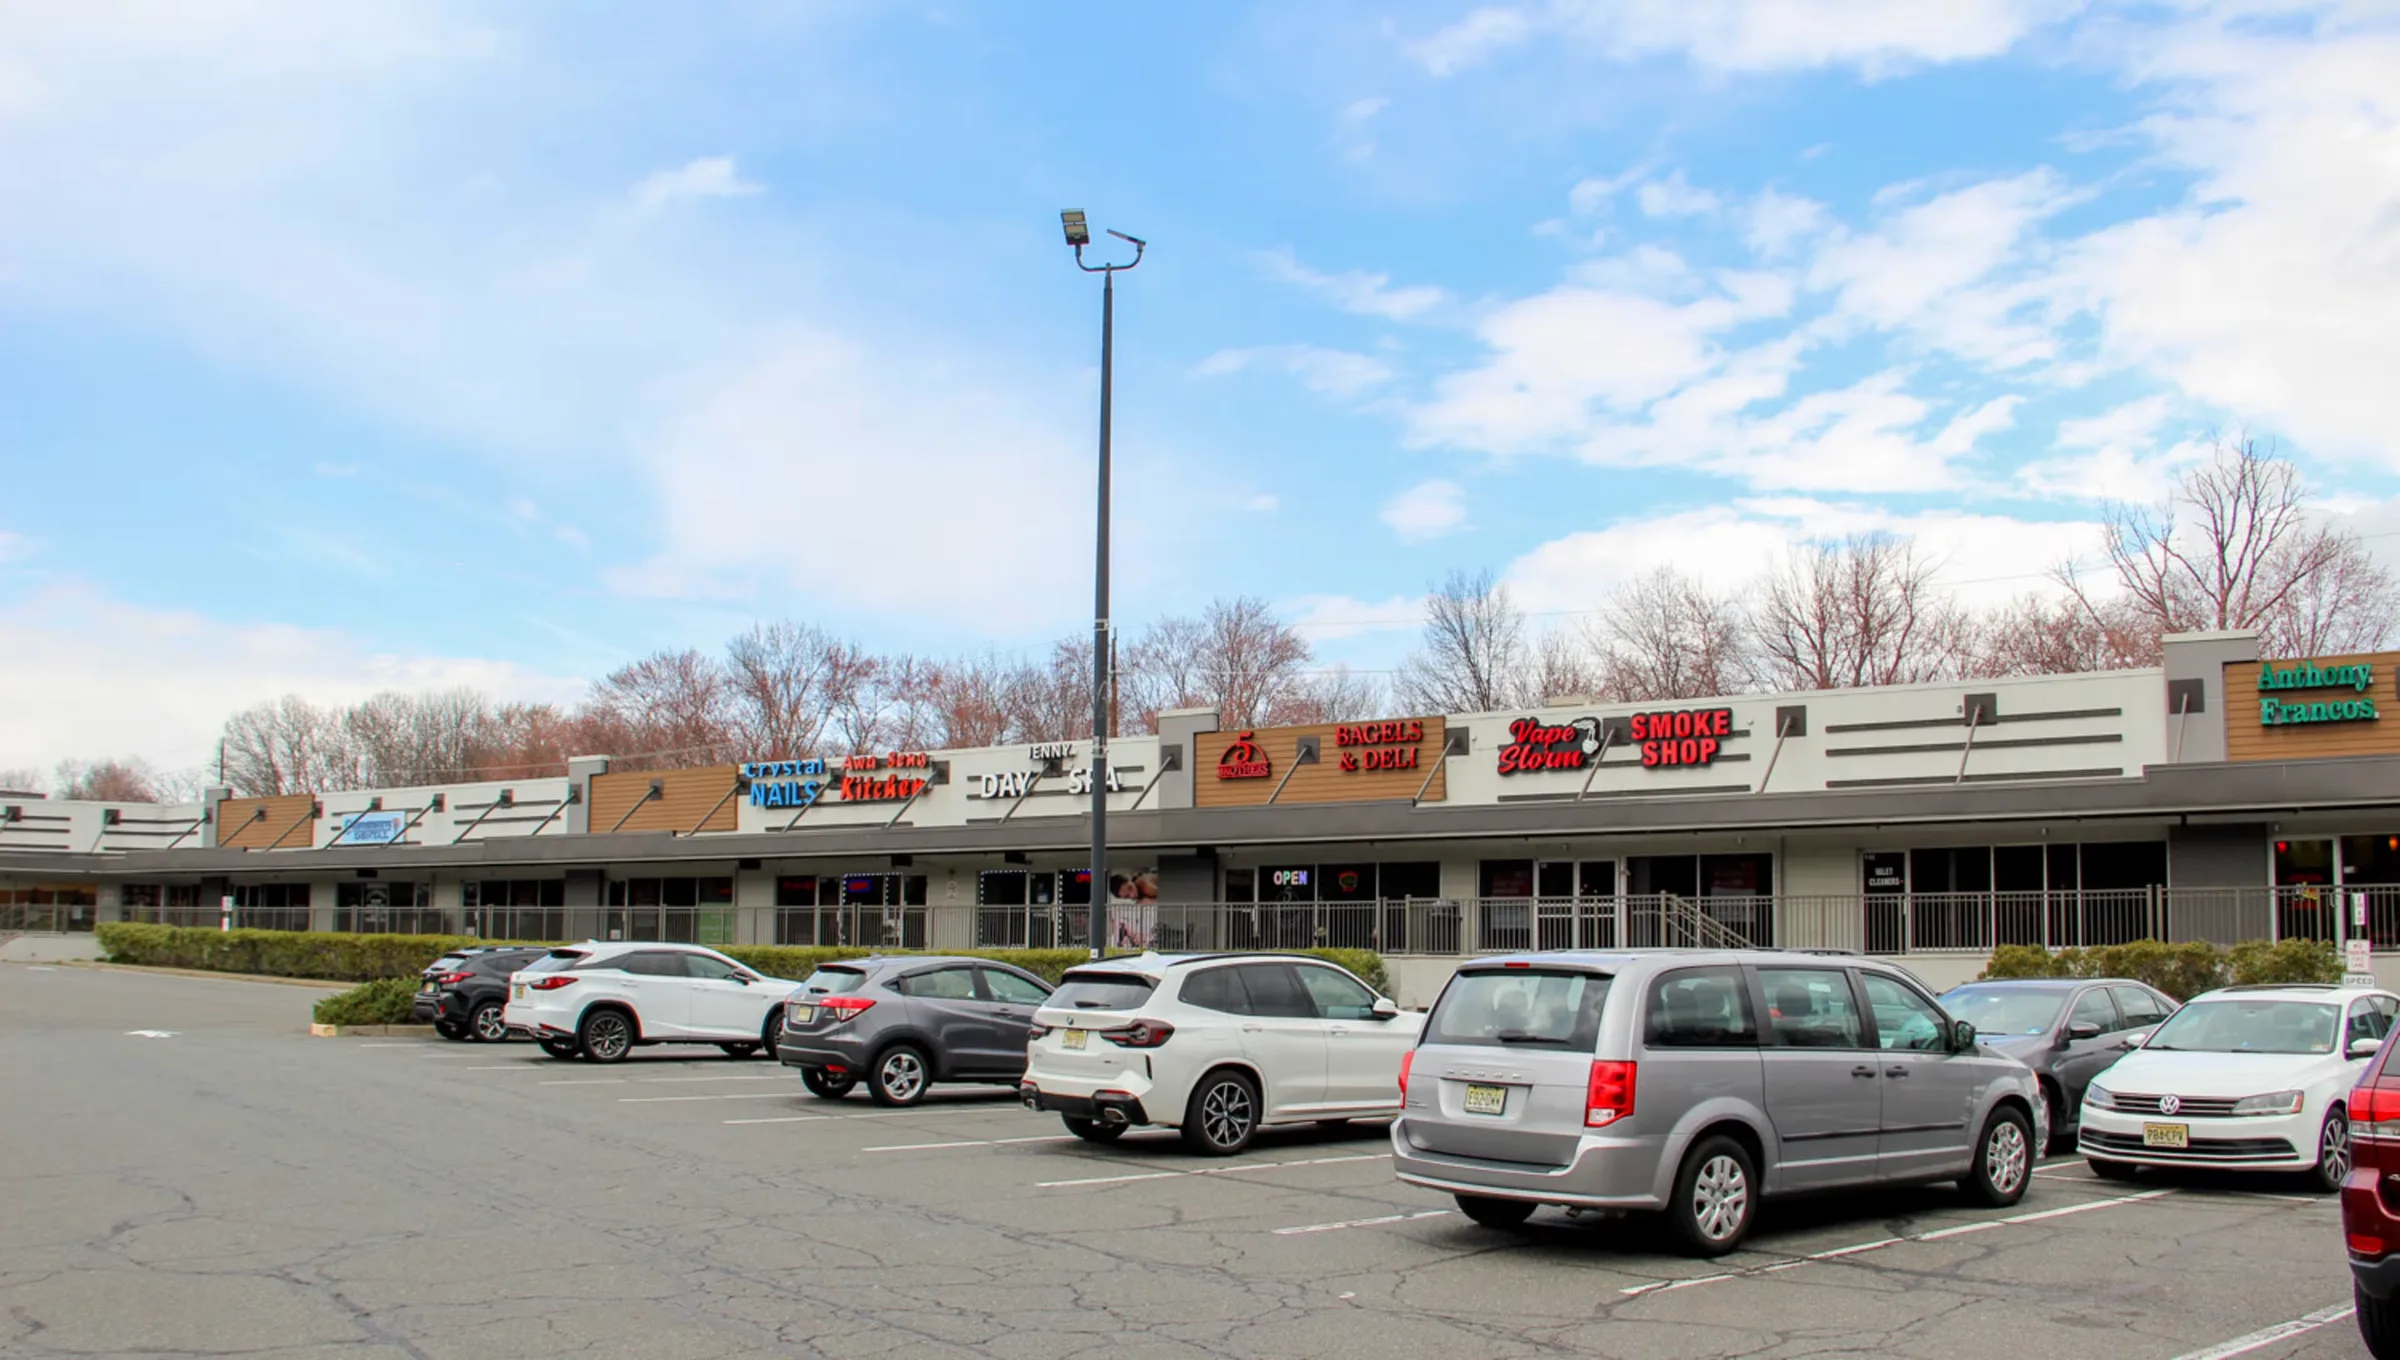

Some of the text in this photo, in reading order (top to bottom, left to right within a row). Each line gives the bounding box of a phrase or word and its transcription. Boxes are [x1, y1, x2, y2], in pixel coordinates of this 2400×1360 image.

[2257, 660, 2372, 691] Anthony
[2259, 697, 2376, 724] Francos
[1335, 720, 1423, 746] BAGELS
[1510, 718, 1577, 747] Vape
[1631, 709, 1730, 741] SMOKE
[1233, 732, 1253, 763] 5
[1339, 746, 1418, 771] & DELI
[1498, 744, 1584, 775] Storm
[1641, 738, 1718, 766] SHOP
[744, 756, 825, 778] Crystal
[841, 754, 878, 771] Awa
[750, 780, 819, 807] NAILS
[840, 773, 927, 801] Kitchen
[980, 770, 1032, 798] DAY
[1273, 870, 1308, 886] OPEN
[2345, 977, 2374, 985] SPEED
